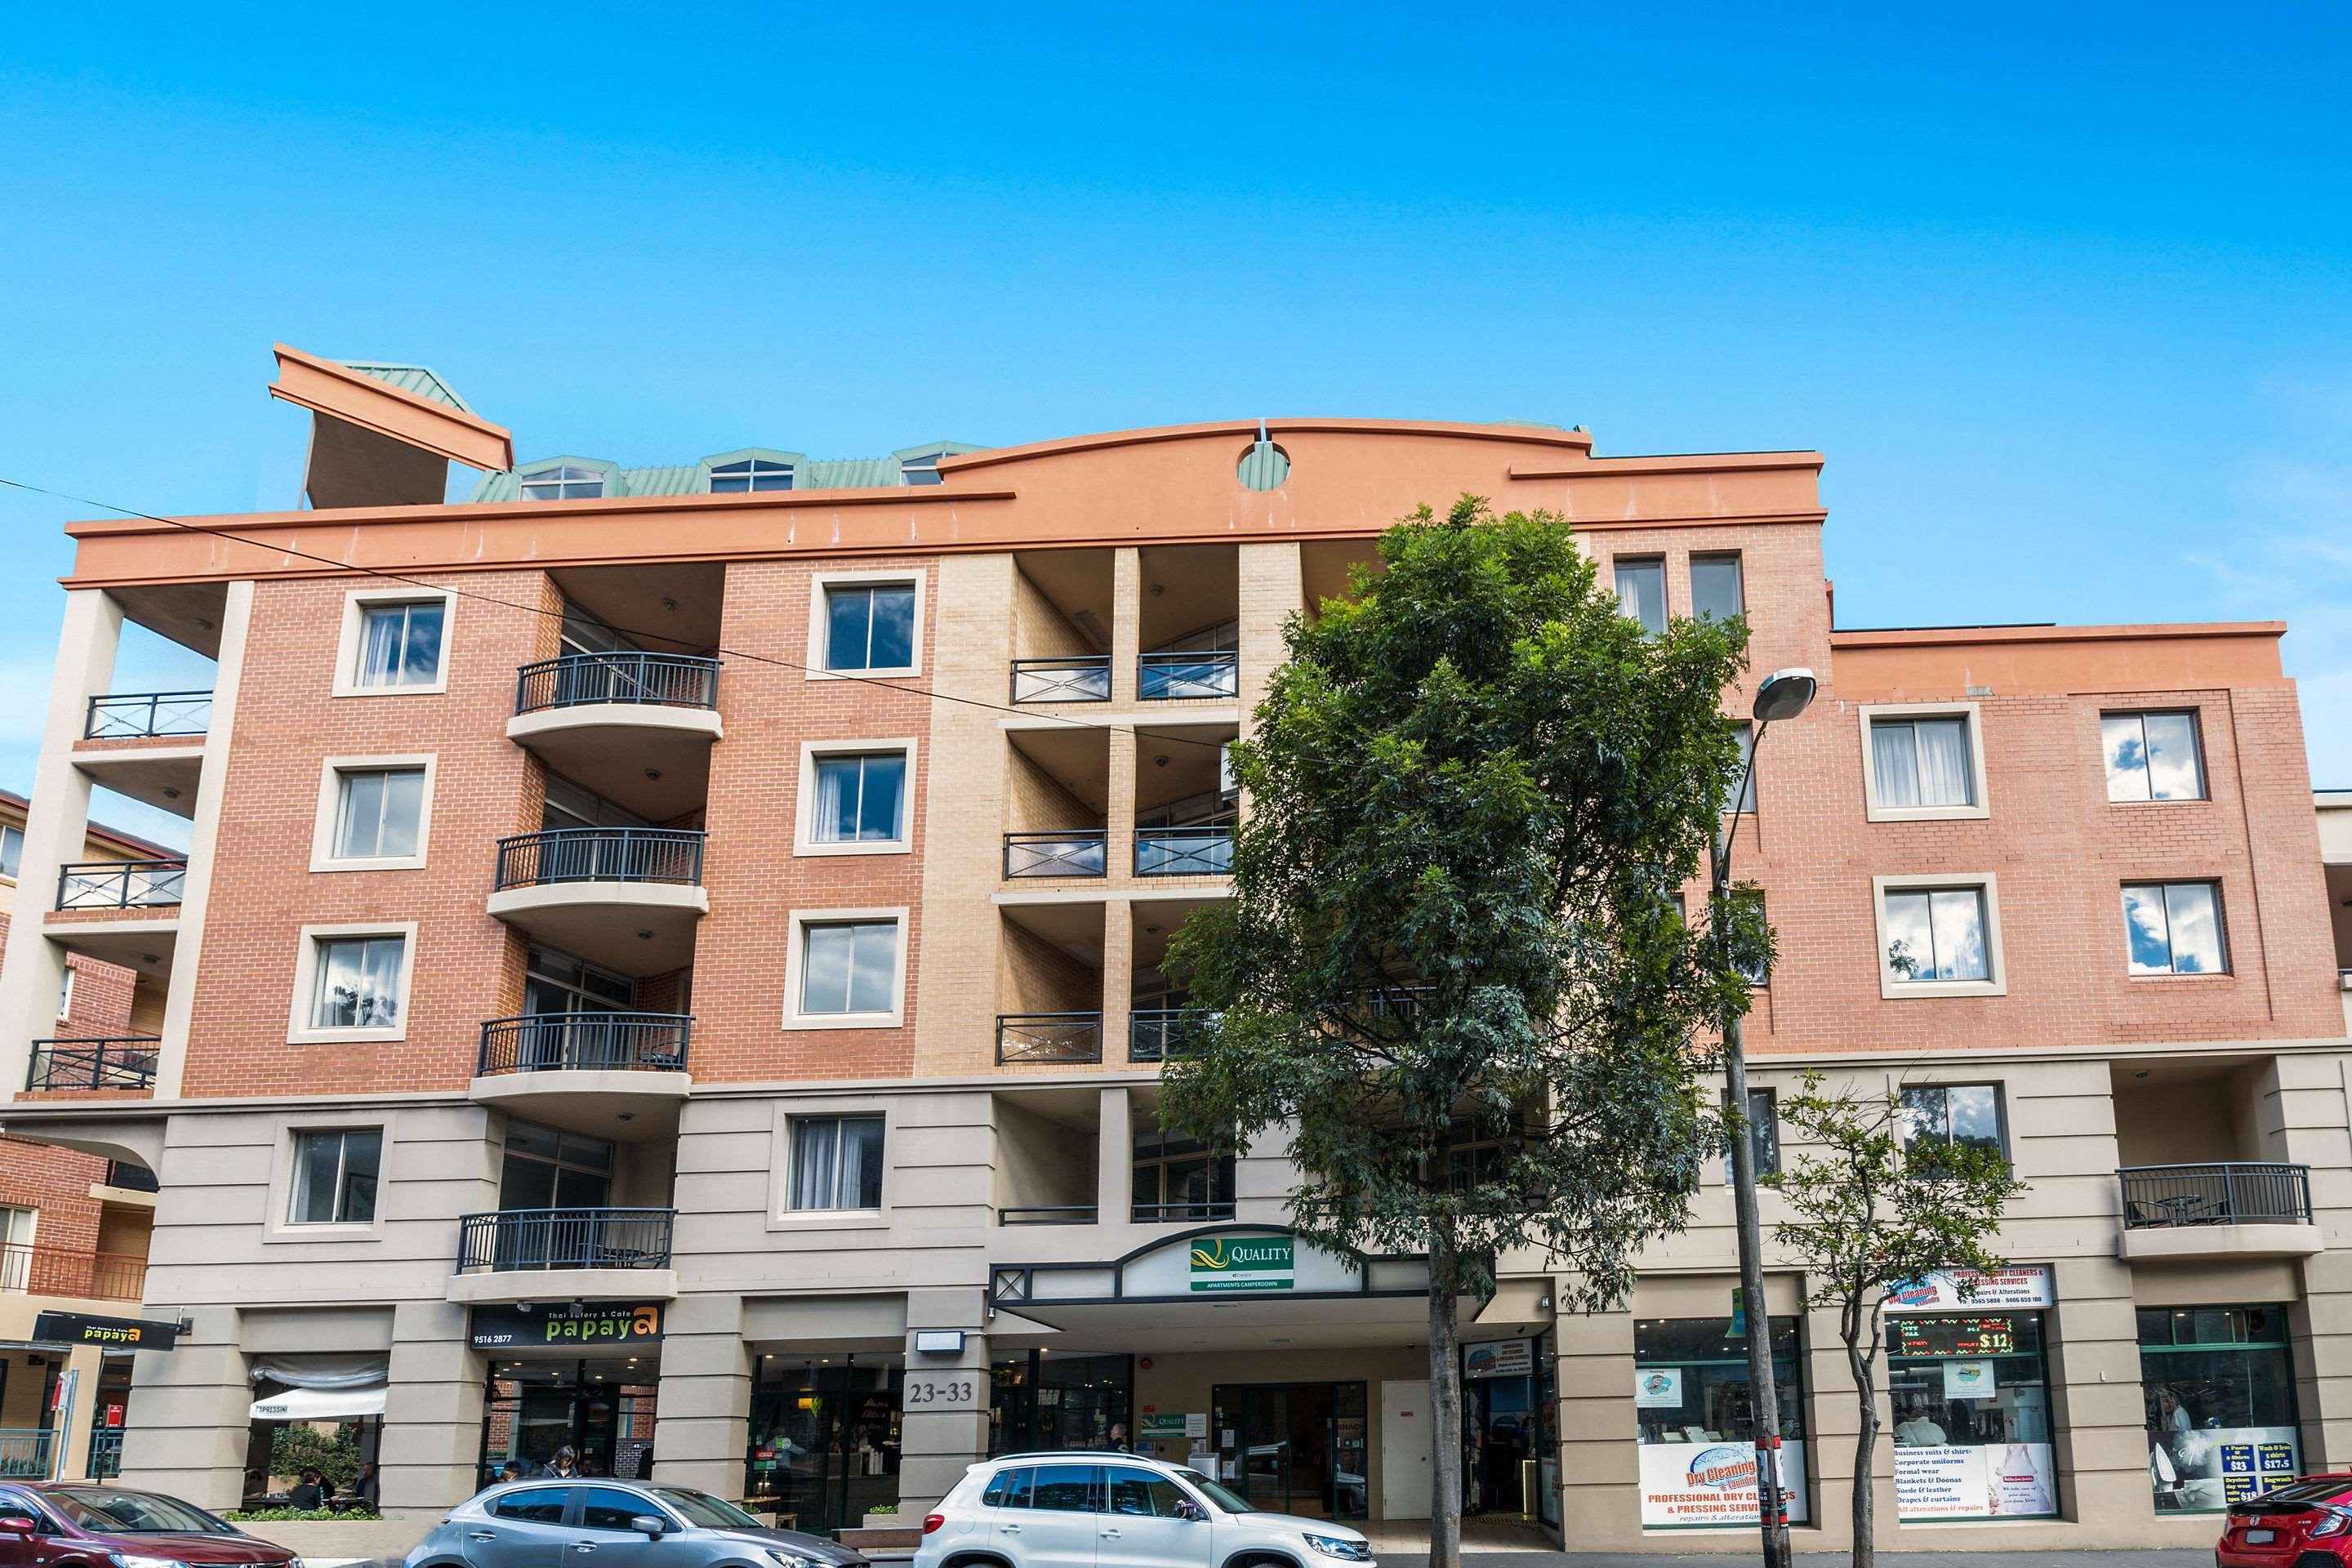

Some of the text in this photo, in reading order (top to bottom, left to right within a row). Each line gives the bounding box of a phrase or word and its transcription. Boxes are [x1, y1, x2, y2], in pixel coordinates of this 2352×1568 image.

[1232, 1246, 1290, 1263] QUALITY
[1953, 1270, 1995, 1278] PROFESSI
[2009, 1268, 2038, 1276] CLEANERS
[1902, 1285, 1937, 1301] Cleaning
[546, 1307, 658, 1341] papaya
[84, 1329, 141, 1342] papaya
[474, 1334, 512, 1343] 9516 2877
[909, 1382, 972, 1403] 23-33
[1159, 1417, 1184, 1425] QUALITY
[2230, 1460, 2247, 1471] $23
[2264, 1459, 2290, 1469] $17.5
[1686, 1460, 1756, 1487] Dry Cleaning
[1728, 1475, 1757, 1490] Laundry
[1648, 1493, 1722, 1503] PROFESSIONAL
[1724, 1493, 1744, 1501] DRY
[1746, 1491, 1796, 1501] CLRS
[1677, 1504, 1726, 1513] PRESSING
[1729, 1503, 1758, 1512] SERVI
[1679, 1514, 1709, 1522] repairs
